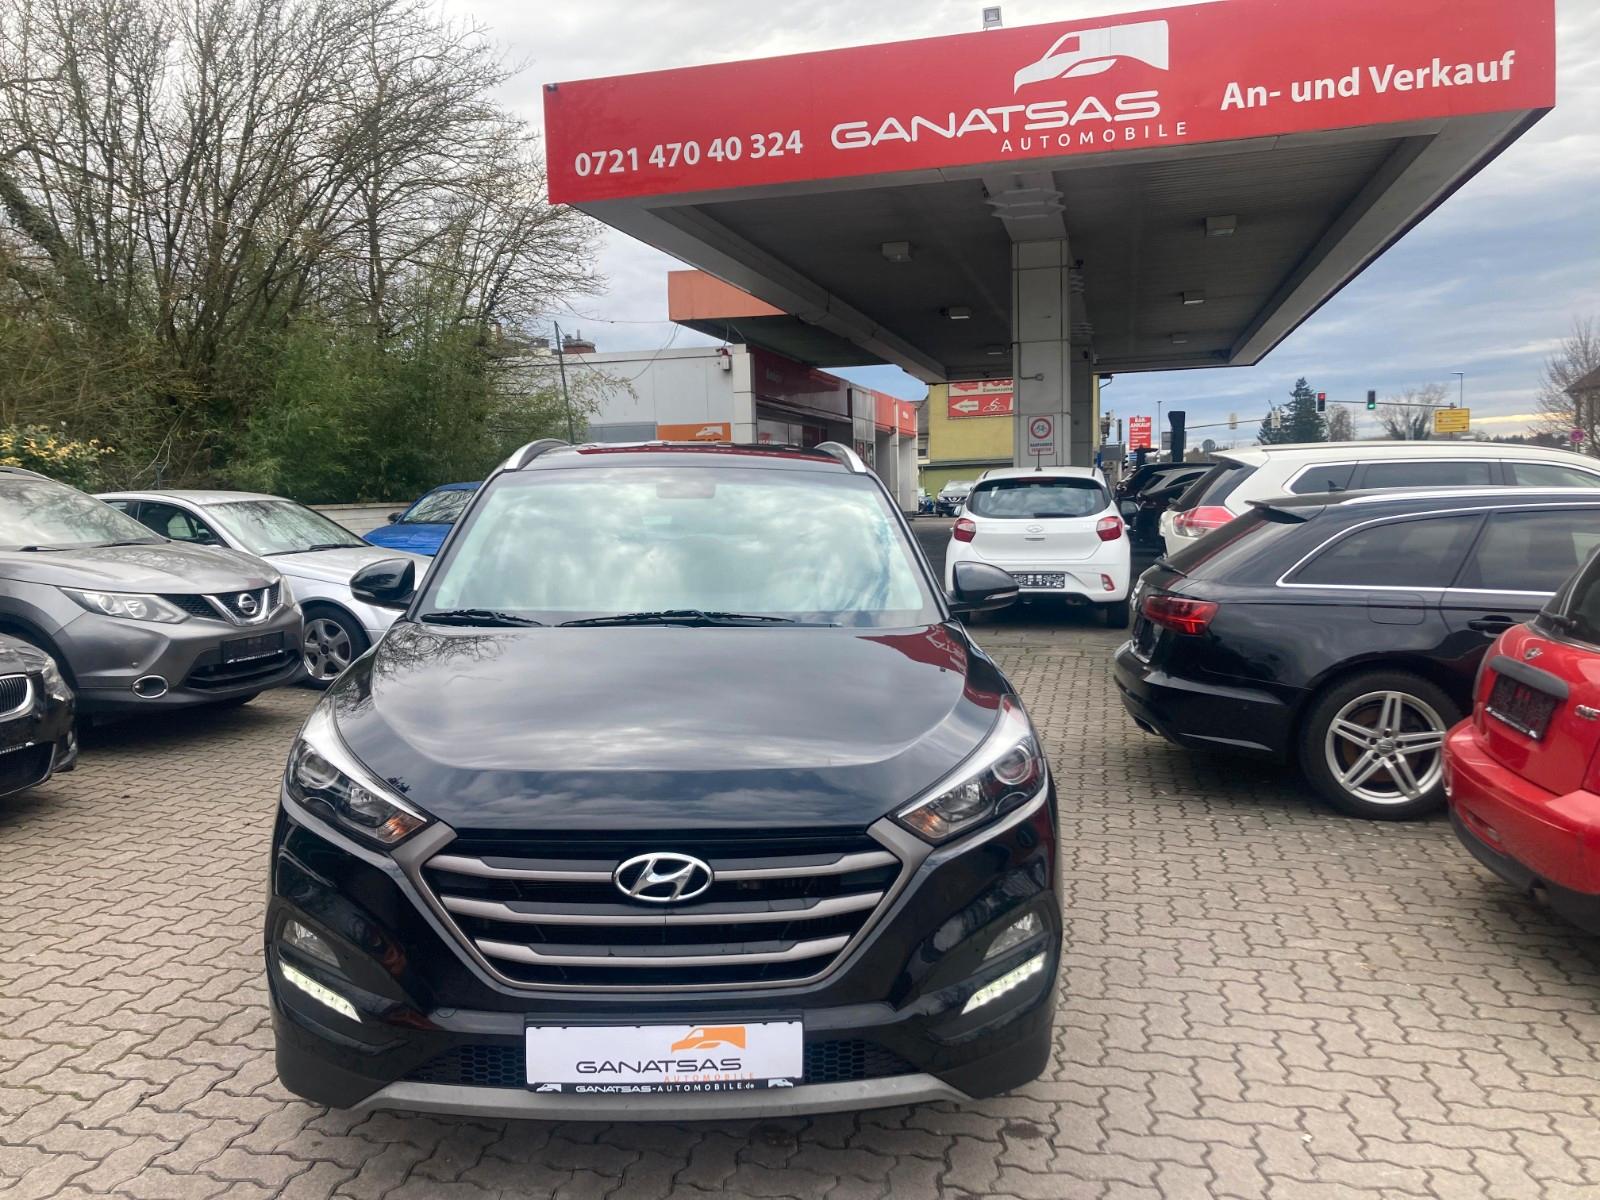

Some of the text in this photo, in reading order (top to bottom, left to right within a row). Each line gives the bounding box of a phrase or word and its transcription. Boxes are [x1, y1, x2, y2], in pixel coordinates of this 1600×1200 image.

[1220, 50, 1515, 111] An- und Verkauf
[830, 89, 1161, 151] GANATSAS
[575, 129, 803, 177] 0721 470 40 324
[1000, 121, 1188, 153] AUTOMOBILE
[575, 1058, 742, 1074] GANATSAS
[663, 1072, 754, 1083] AUTOMOBILE
[575, 1082, 755, 1094] GANATSAS-AUTOMOBILE.de
